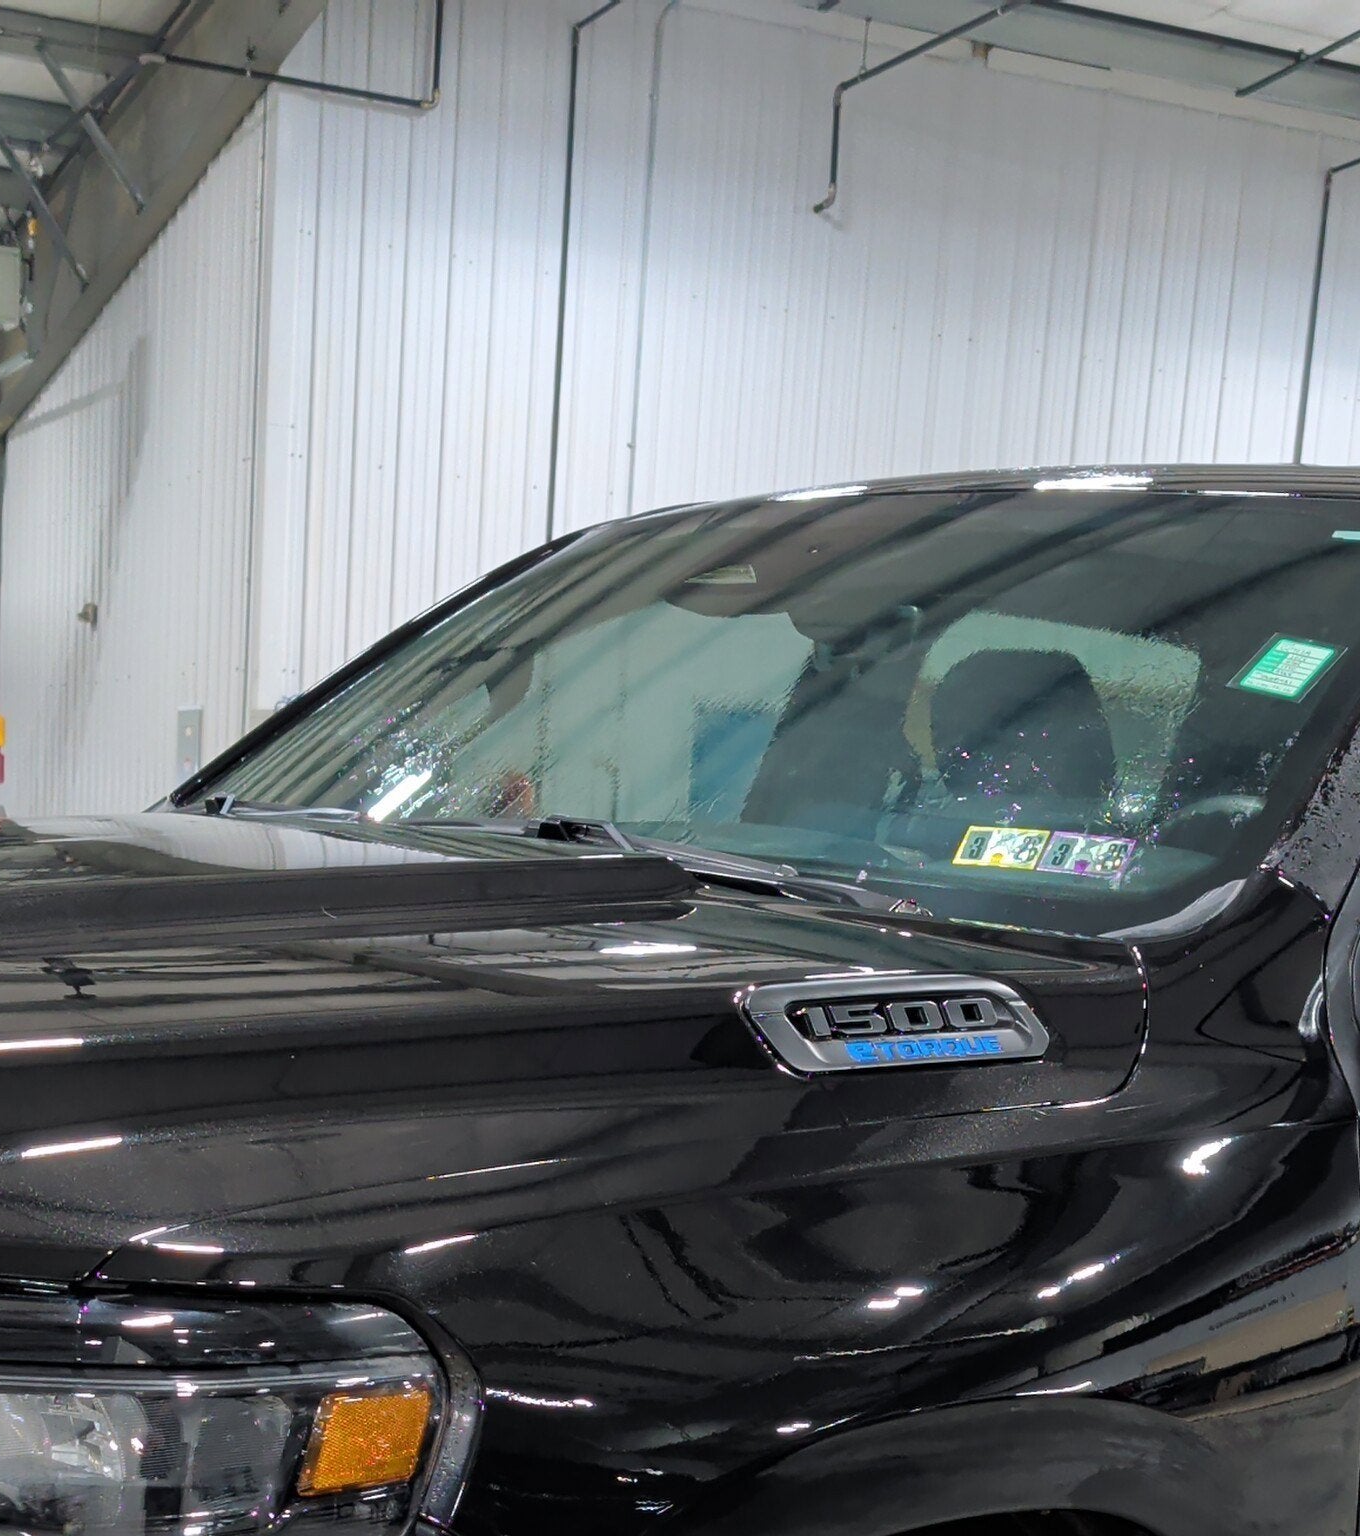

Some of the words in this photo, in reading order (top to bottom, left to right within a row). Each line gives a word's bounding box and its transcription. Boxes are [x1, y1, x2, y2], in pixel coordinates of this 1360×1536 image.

[968, 836, 987, 861] 3
[1050, 843, 1071, 867] 3
[803, 997, 998, 1037] 1500
